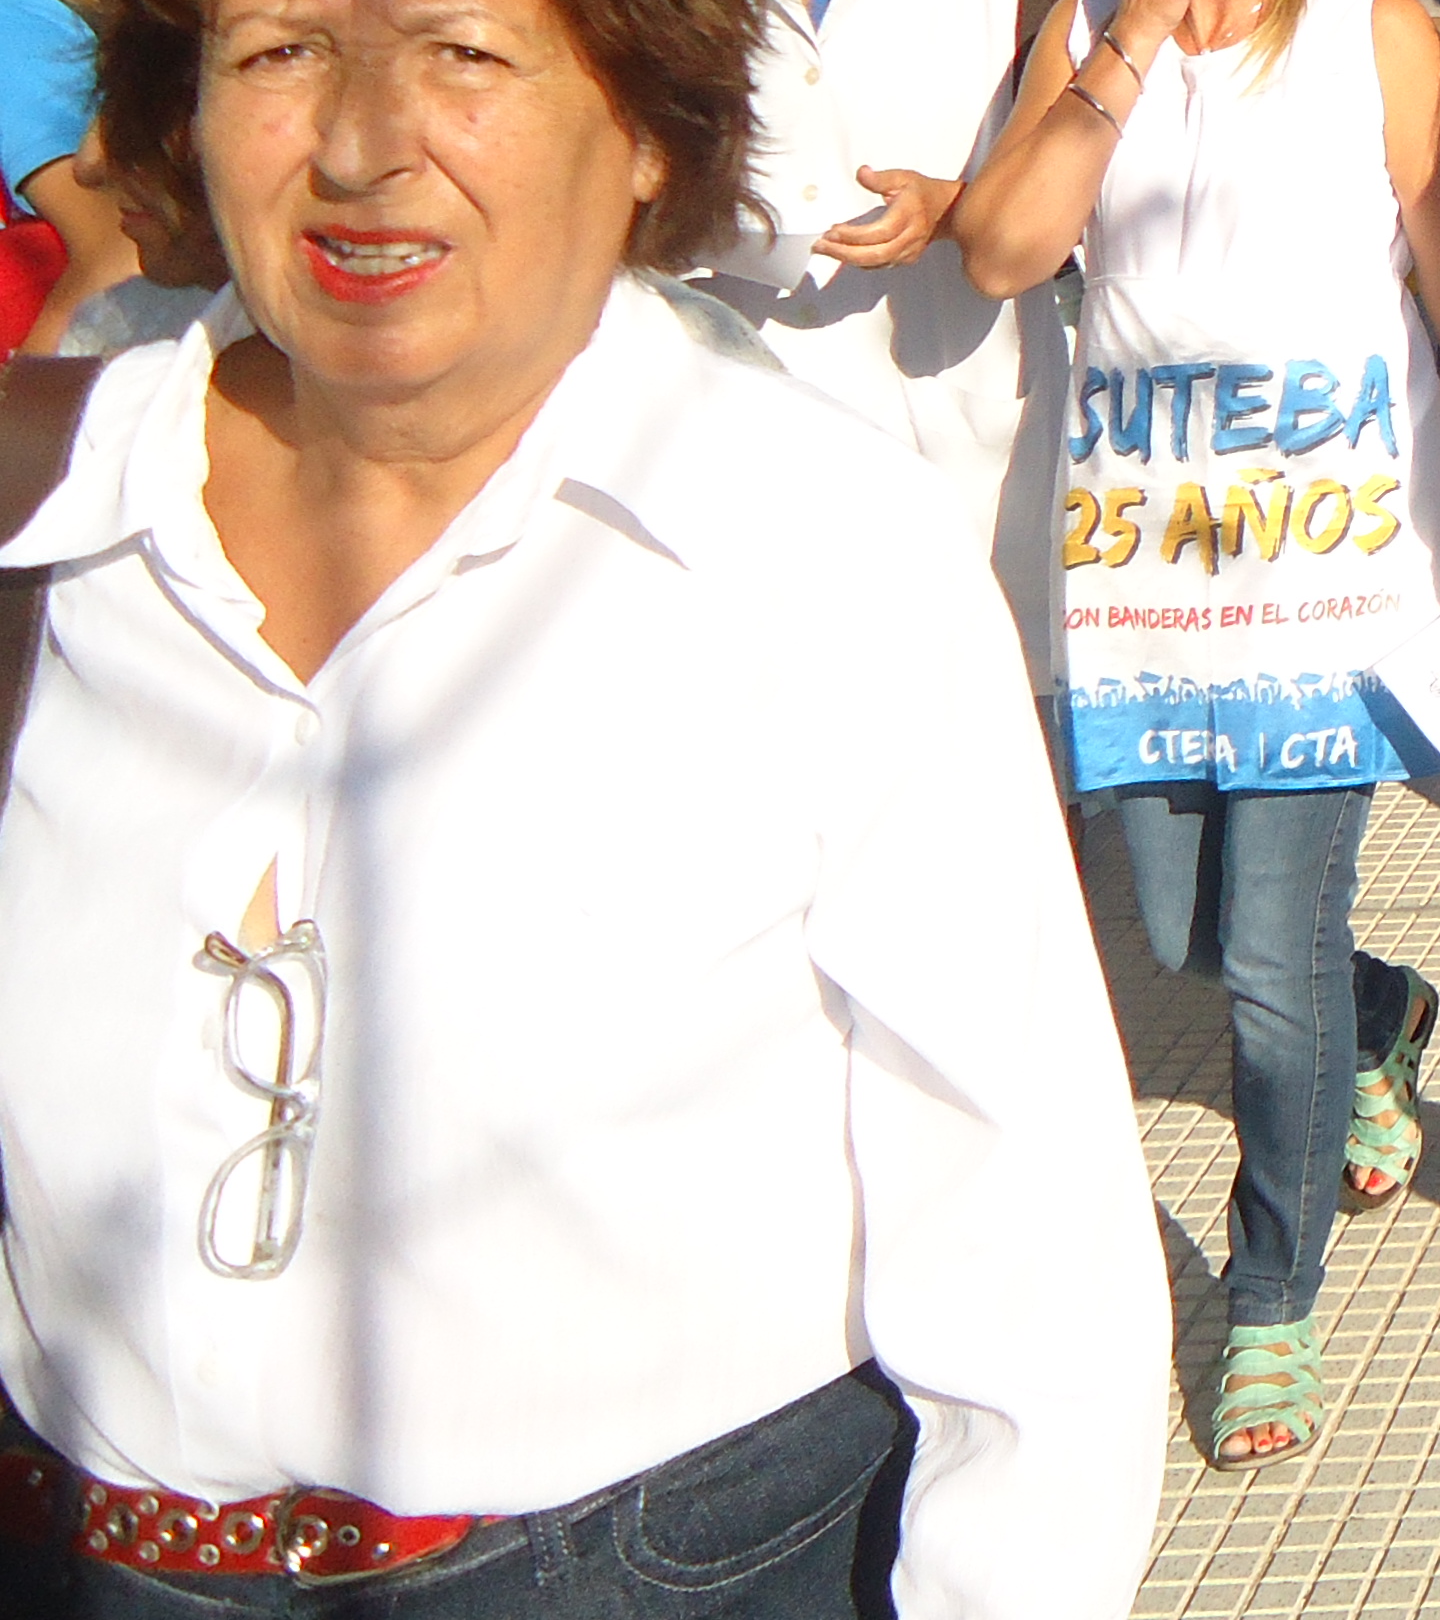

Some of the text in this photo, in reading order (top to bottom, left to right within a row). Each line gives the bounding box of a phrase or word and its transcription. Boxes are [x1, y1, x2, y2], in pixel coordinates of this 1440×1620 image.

[1068, 353, 1400, 466] SUTEBA
[1062, 467, 1402, 577] 25 AÑOS
[1063, 589, 1402, 633] ON BANDERAS EN EL CORAZÓN
[1280, 725, 1358, 770] CTA
